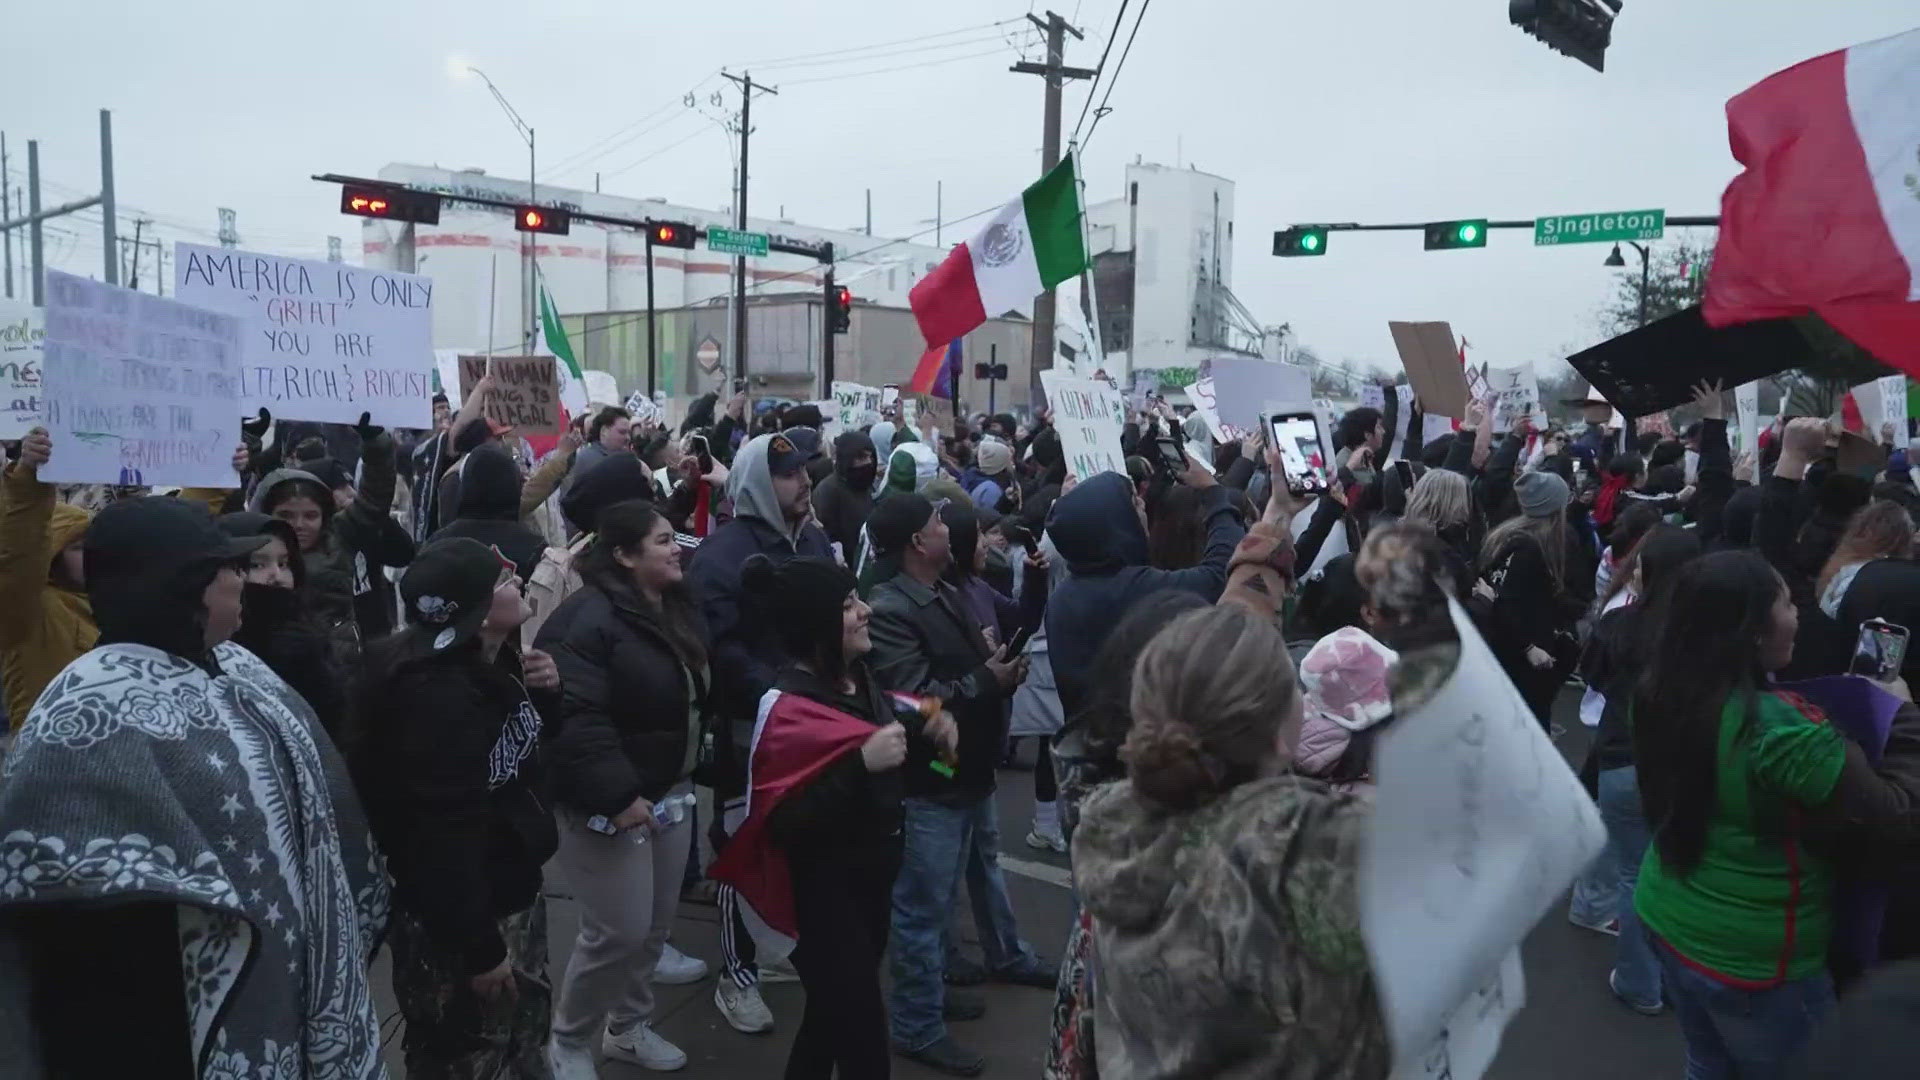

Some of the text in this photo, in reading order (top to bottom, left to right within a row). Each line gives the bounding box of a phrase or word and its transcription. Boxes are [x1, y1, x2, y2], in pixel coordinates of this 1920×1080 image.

[1543, 214, 1655, 236] Singleton
[184, 251, 432, 309] AMERICA IS ONLY
[264, 330, 310, 356] YOU
[363, 368, 428, 400] RACIST
